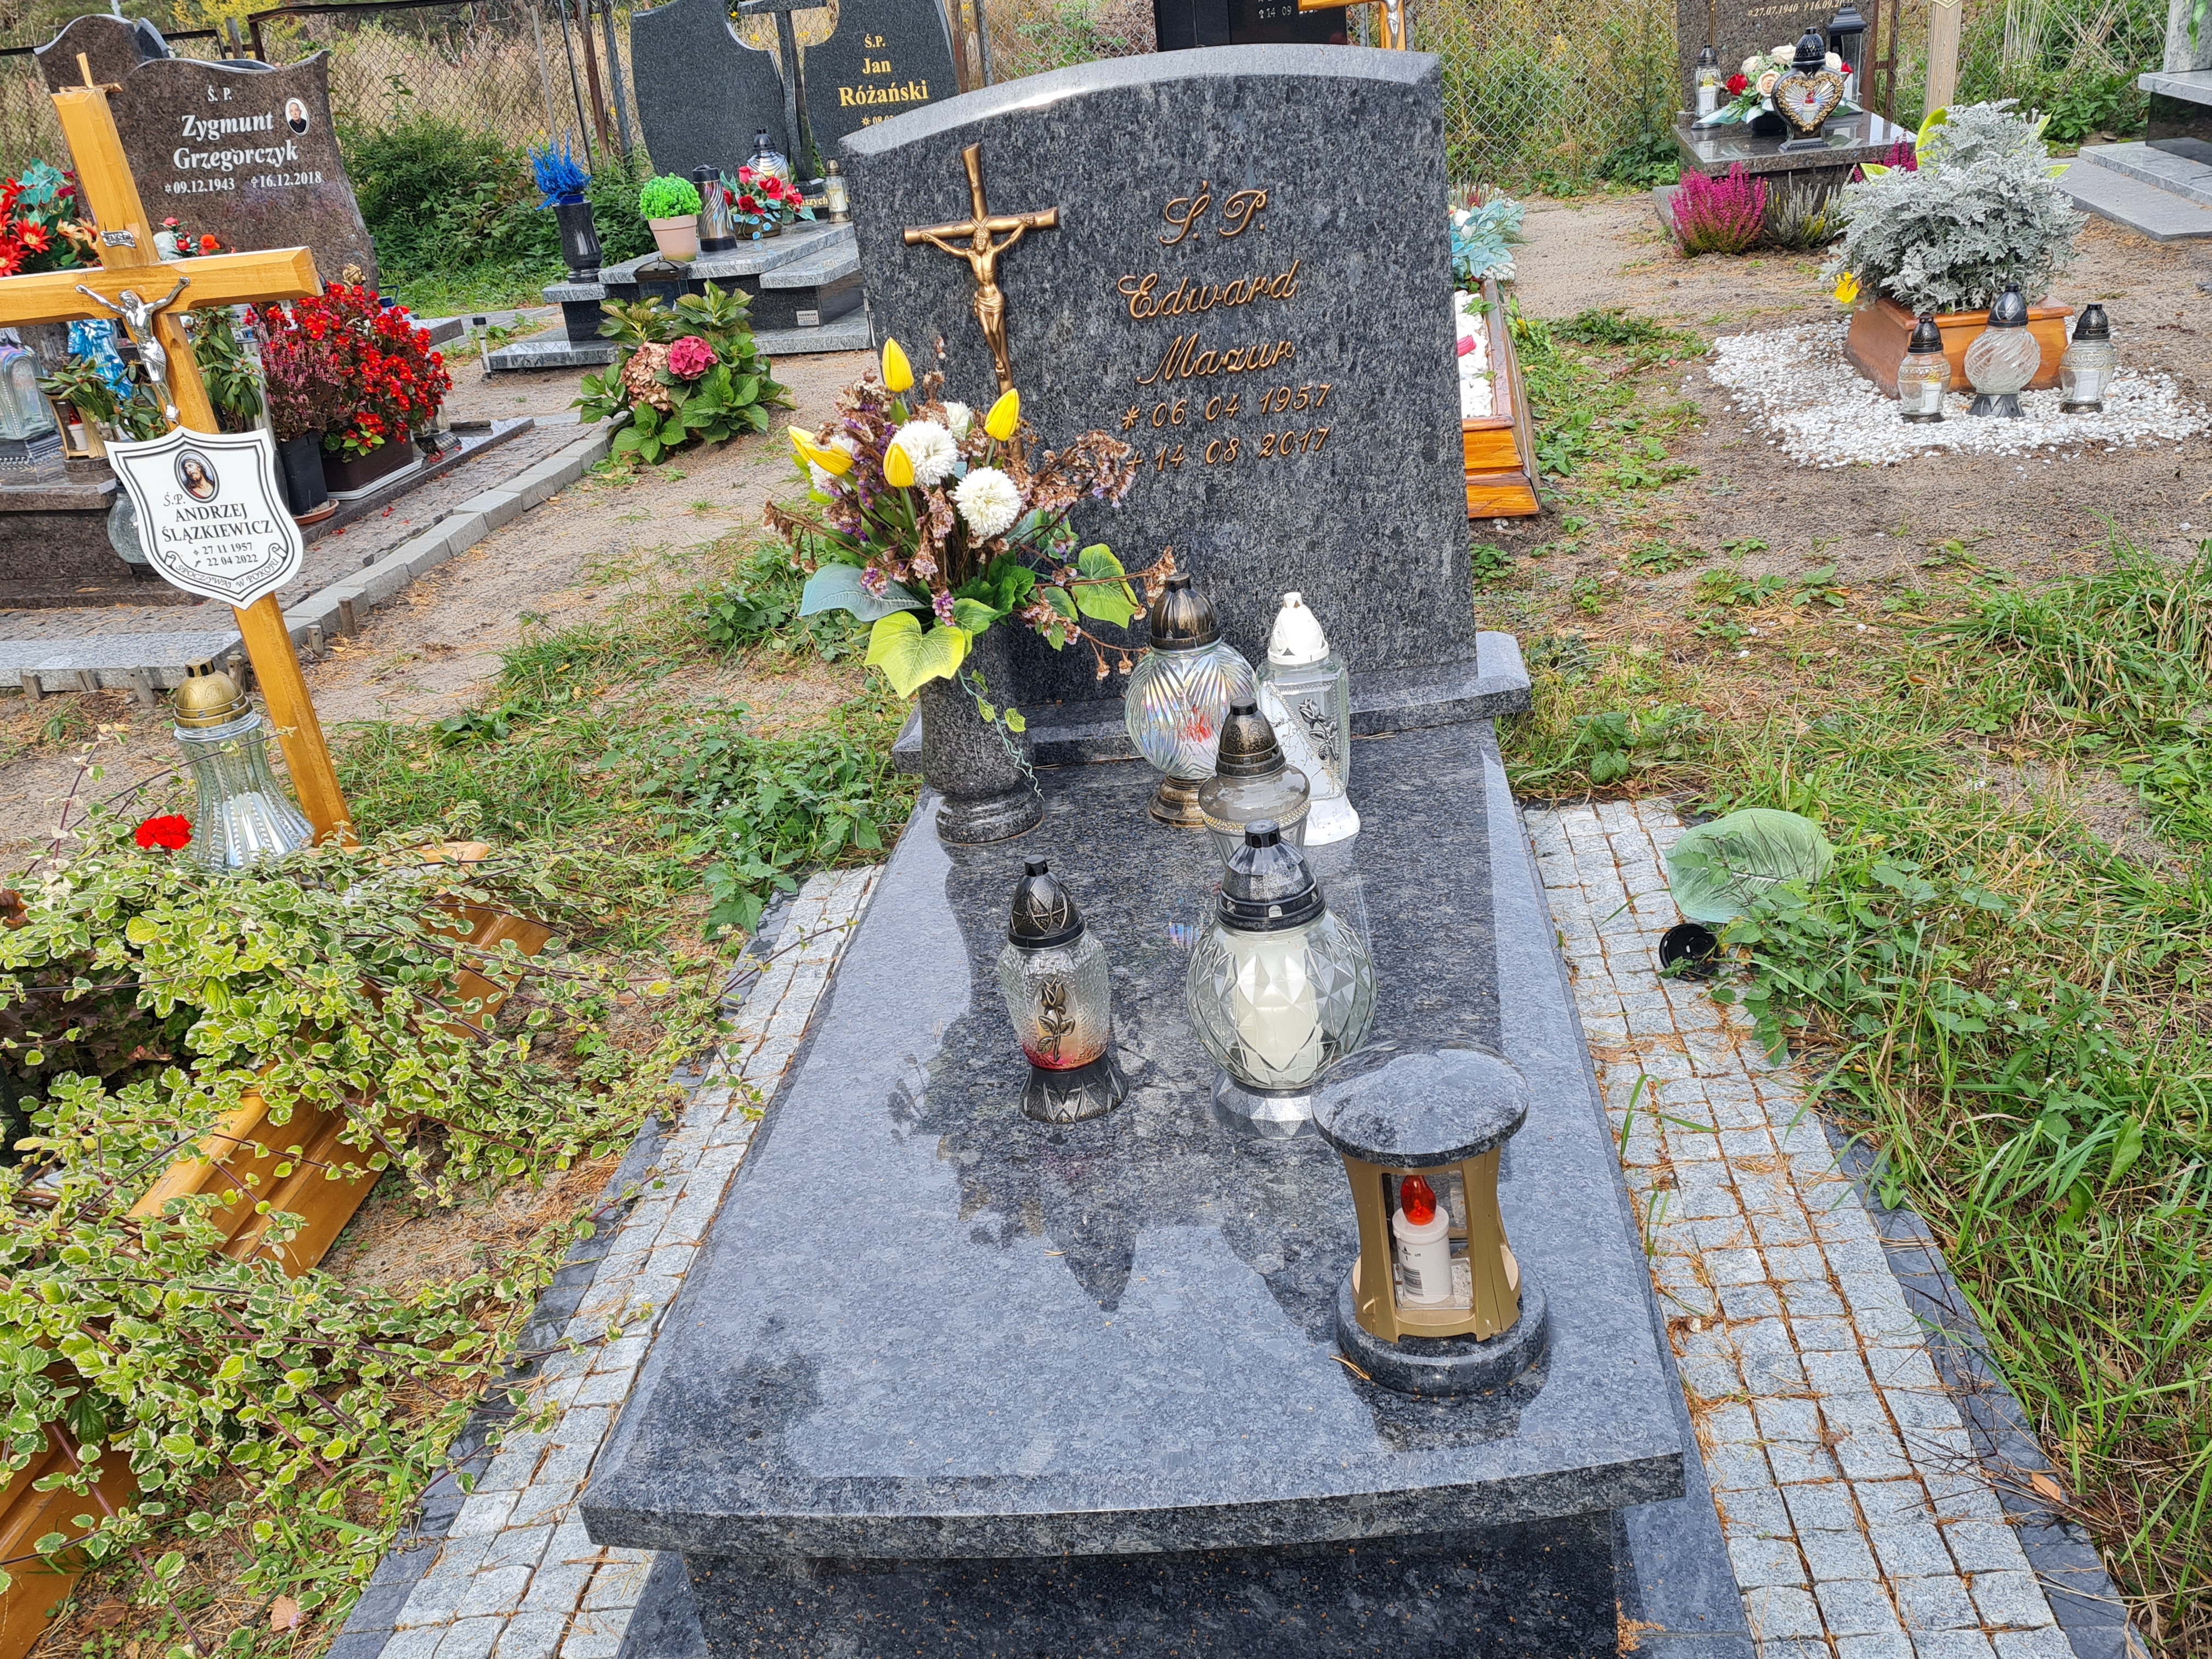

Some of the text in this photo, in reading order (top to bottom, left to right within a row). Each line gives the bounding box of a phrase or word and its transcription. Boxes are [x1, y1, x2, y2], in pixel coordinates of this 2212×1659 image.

[1266, 7, 1276, 18] 14
[1282, 5, 1291, 16] 09
[1754, 3, 1798, 16] 27.07.1940
[864, 33, 885, 48] Ś.P.
[862, 58, 891, 74] Jan
[208, 85, 232, 102] Ś. P.
[838, 80, 929, 106] Różański
[182, 111, 274, 142] Zygmunt
[173, 139, 298, 172] Grzegorczyk
[173, 171, 322, 194] 09.12.1943 16.12.2018
[1118, 258, 1301, 320] Edward
[1136, 332, 1295, 384] Mazur
[1152, 382, 1331, 428] 06 04 1957
[1154, 427, 1330, 471] 14 08 2017
[163, 492, 186, 506] Ś.P.
[176, 503, 247, 522] ANDRZEJ
[162, 520, 273, 544] ŚLĄZKIEWICZ
[202, 542, 253, 554] 27 11 1957
[206, 554, 258, 566] 22 04 2022
[176, 558, 280, 588] SPOCZYWAJ W POKOJU
